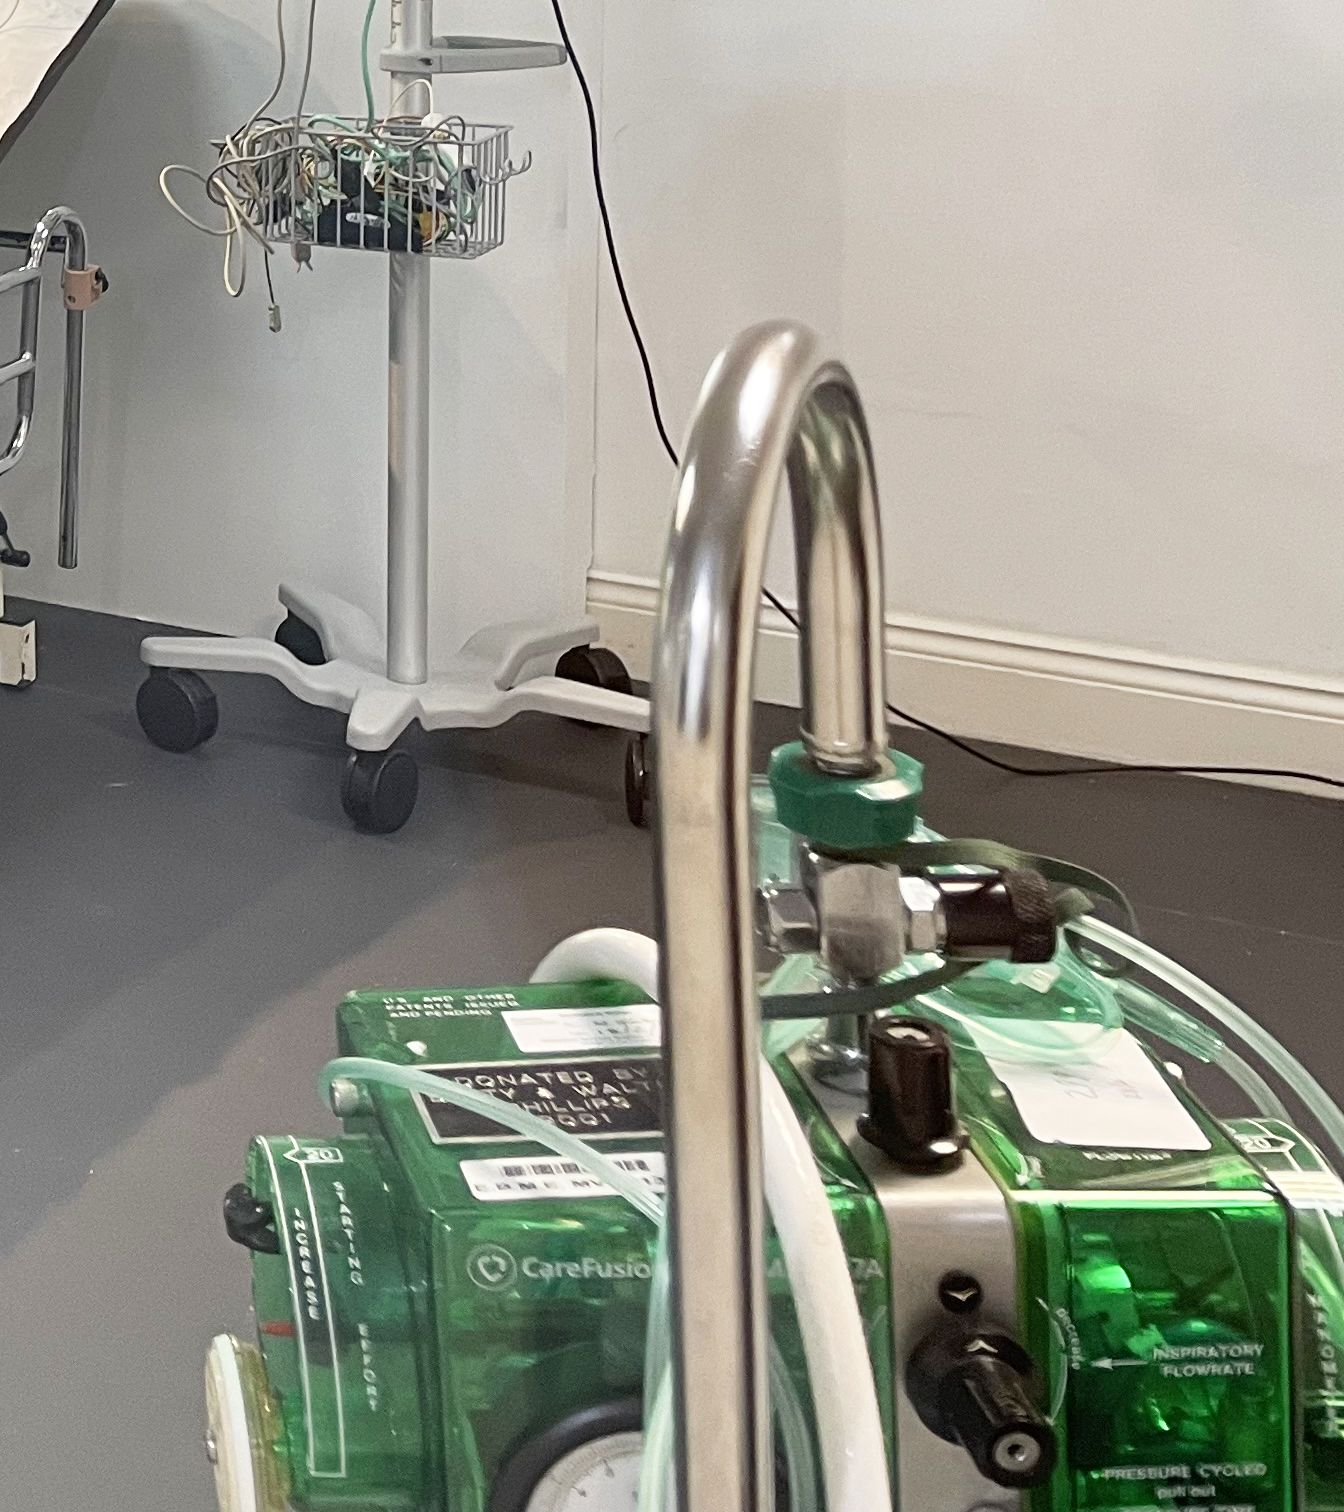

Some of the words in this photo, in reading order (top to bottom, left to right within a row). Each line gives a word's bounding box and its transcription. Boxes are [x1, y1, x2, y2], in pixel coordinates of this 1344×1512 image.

[454, 1070, 594, 1090] DONATED
[572, 1080, 664, 1099] WALT
[517, 1094, 632, 1115] HILLIPS
[306, 1149, 334, 1161] 20
[294, 1207, 321, 1321] INCREASE
[522, 1254, 652, 1279] CareFusio
[332, 1181, 365, 1287] STARTING
[358, 1322, 378, 1412] EFFORT
[1153, 1343, 1265, 1361] INSPIRATORY
[1161, 1362, 1256, 1378] FLOWRATE
[1102, 1464, 1191, 1480] PRESSURE
[1196, 1462, 1268, 1478] CYCLED
